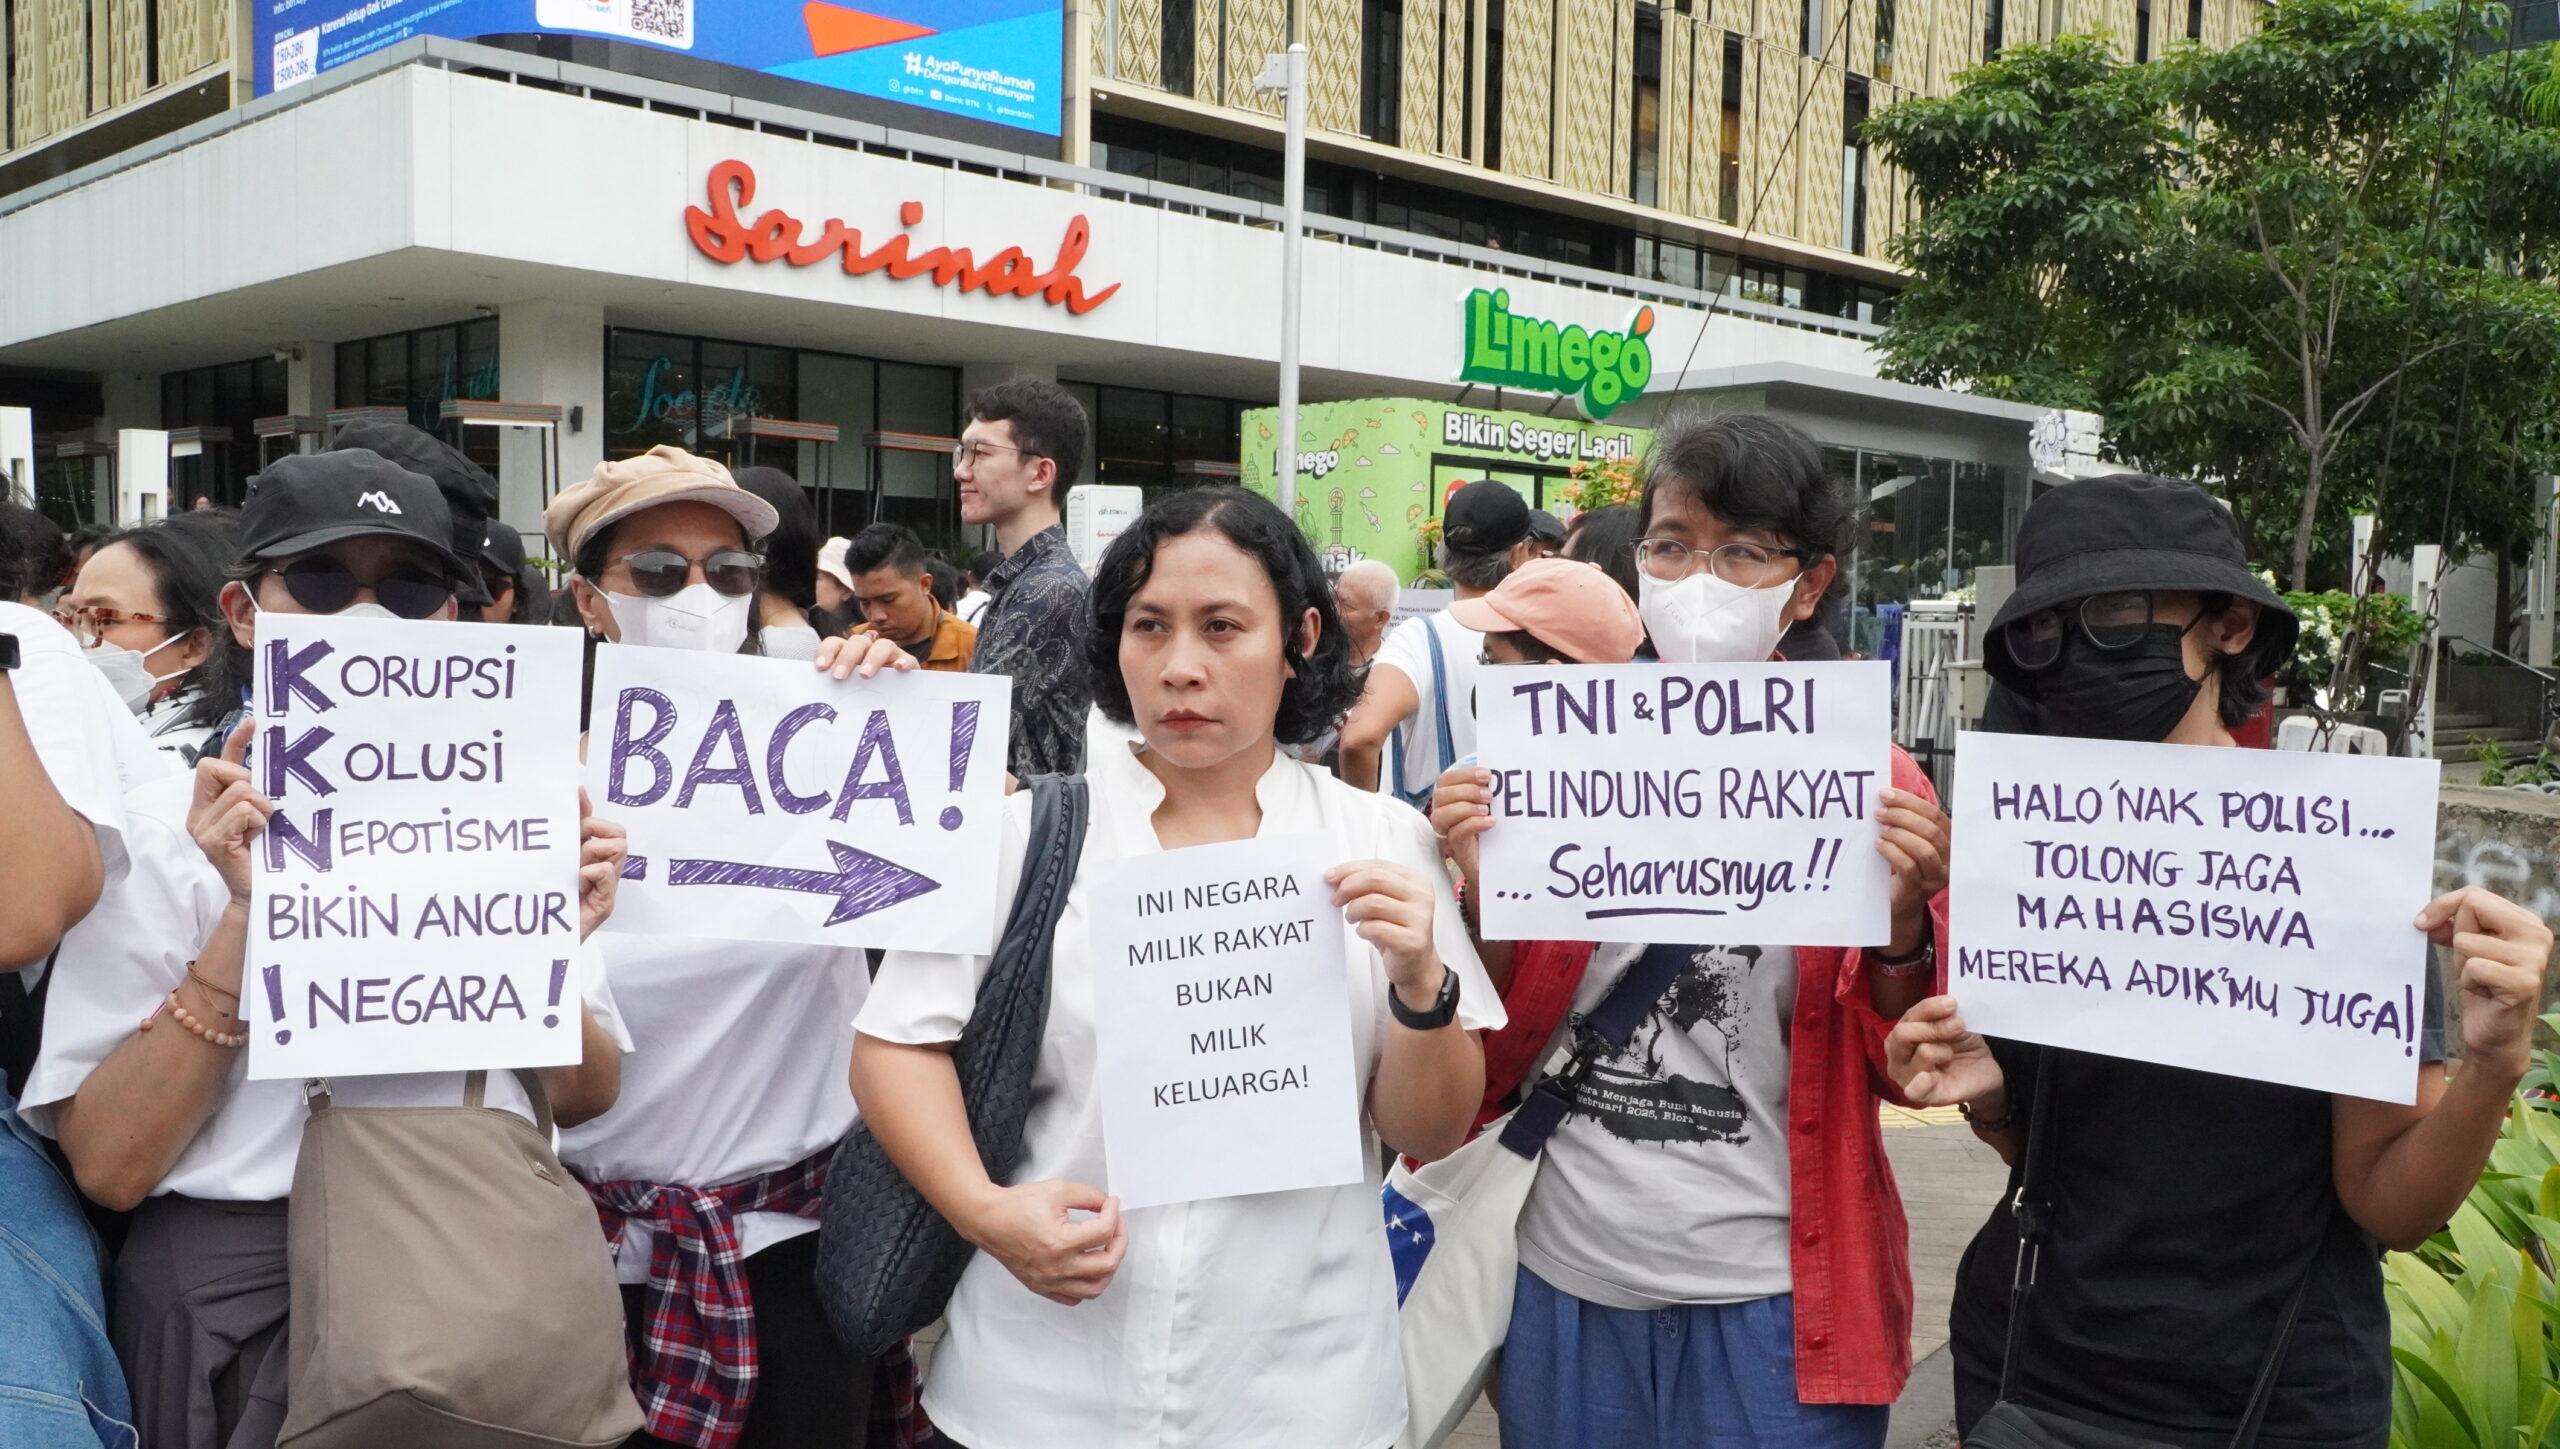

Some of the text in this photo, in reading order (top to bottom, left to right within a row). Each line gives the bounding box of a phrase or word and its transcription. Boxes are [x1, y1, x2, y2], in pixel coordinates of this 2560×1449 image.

[275, 40, 305, 62] 150-286
[275, 59, 309, 84] 1500-286
[685, 159, 1121, 314] Sarinah
[1444, 412, 1505, 449] Bikin
[1508, 420, 1576, 461] Seger
[1512, 676, 1815, 736] TNI & POLRI
[1719, 767, 1875, 820] RAKYAT
[1993, 782, 2102, 823] HALO
[2024, 840, 2302, 896] TOLONG JAGA
[414, 893, 572, 940] ANCUR
[1137, 874, 1300, 917] INI NEGARA
[1128, 919, 1315, 966] MILIK RAKYAT
[2017, 893, 2315, 950] MAHASISWA
[1176, 973, 1273, 1006] BUKAN
[1959, 946, 2111, 992] MEREKA
[2294, 984, 2416, 1058] JUGA!
[1190, 1024, 1267, 1055] MILIK
[1154, 1065, 1309, 1107] KELUARGA!
[1602, 1089, 1654, 1108] Menjaga
[1658, 1099, 1687, 1111] Bumi
[1690, 1104, 1743, 1119] Manusia
[1662, 1111, 1695, 1124] Blora
